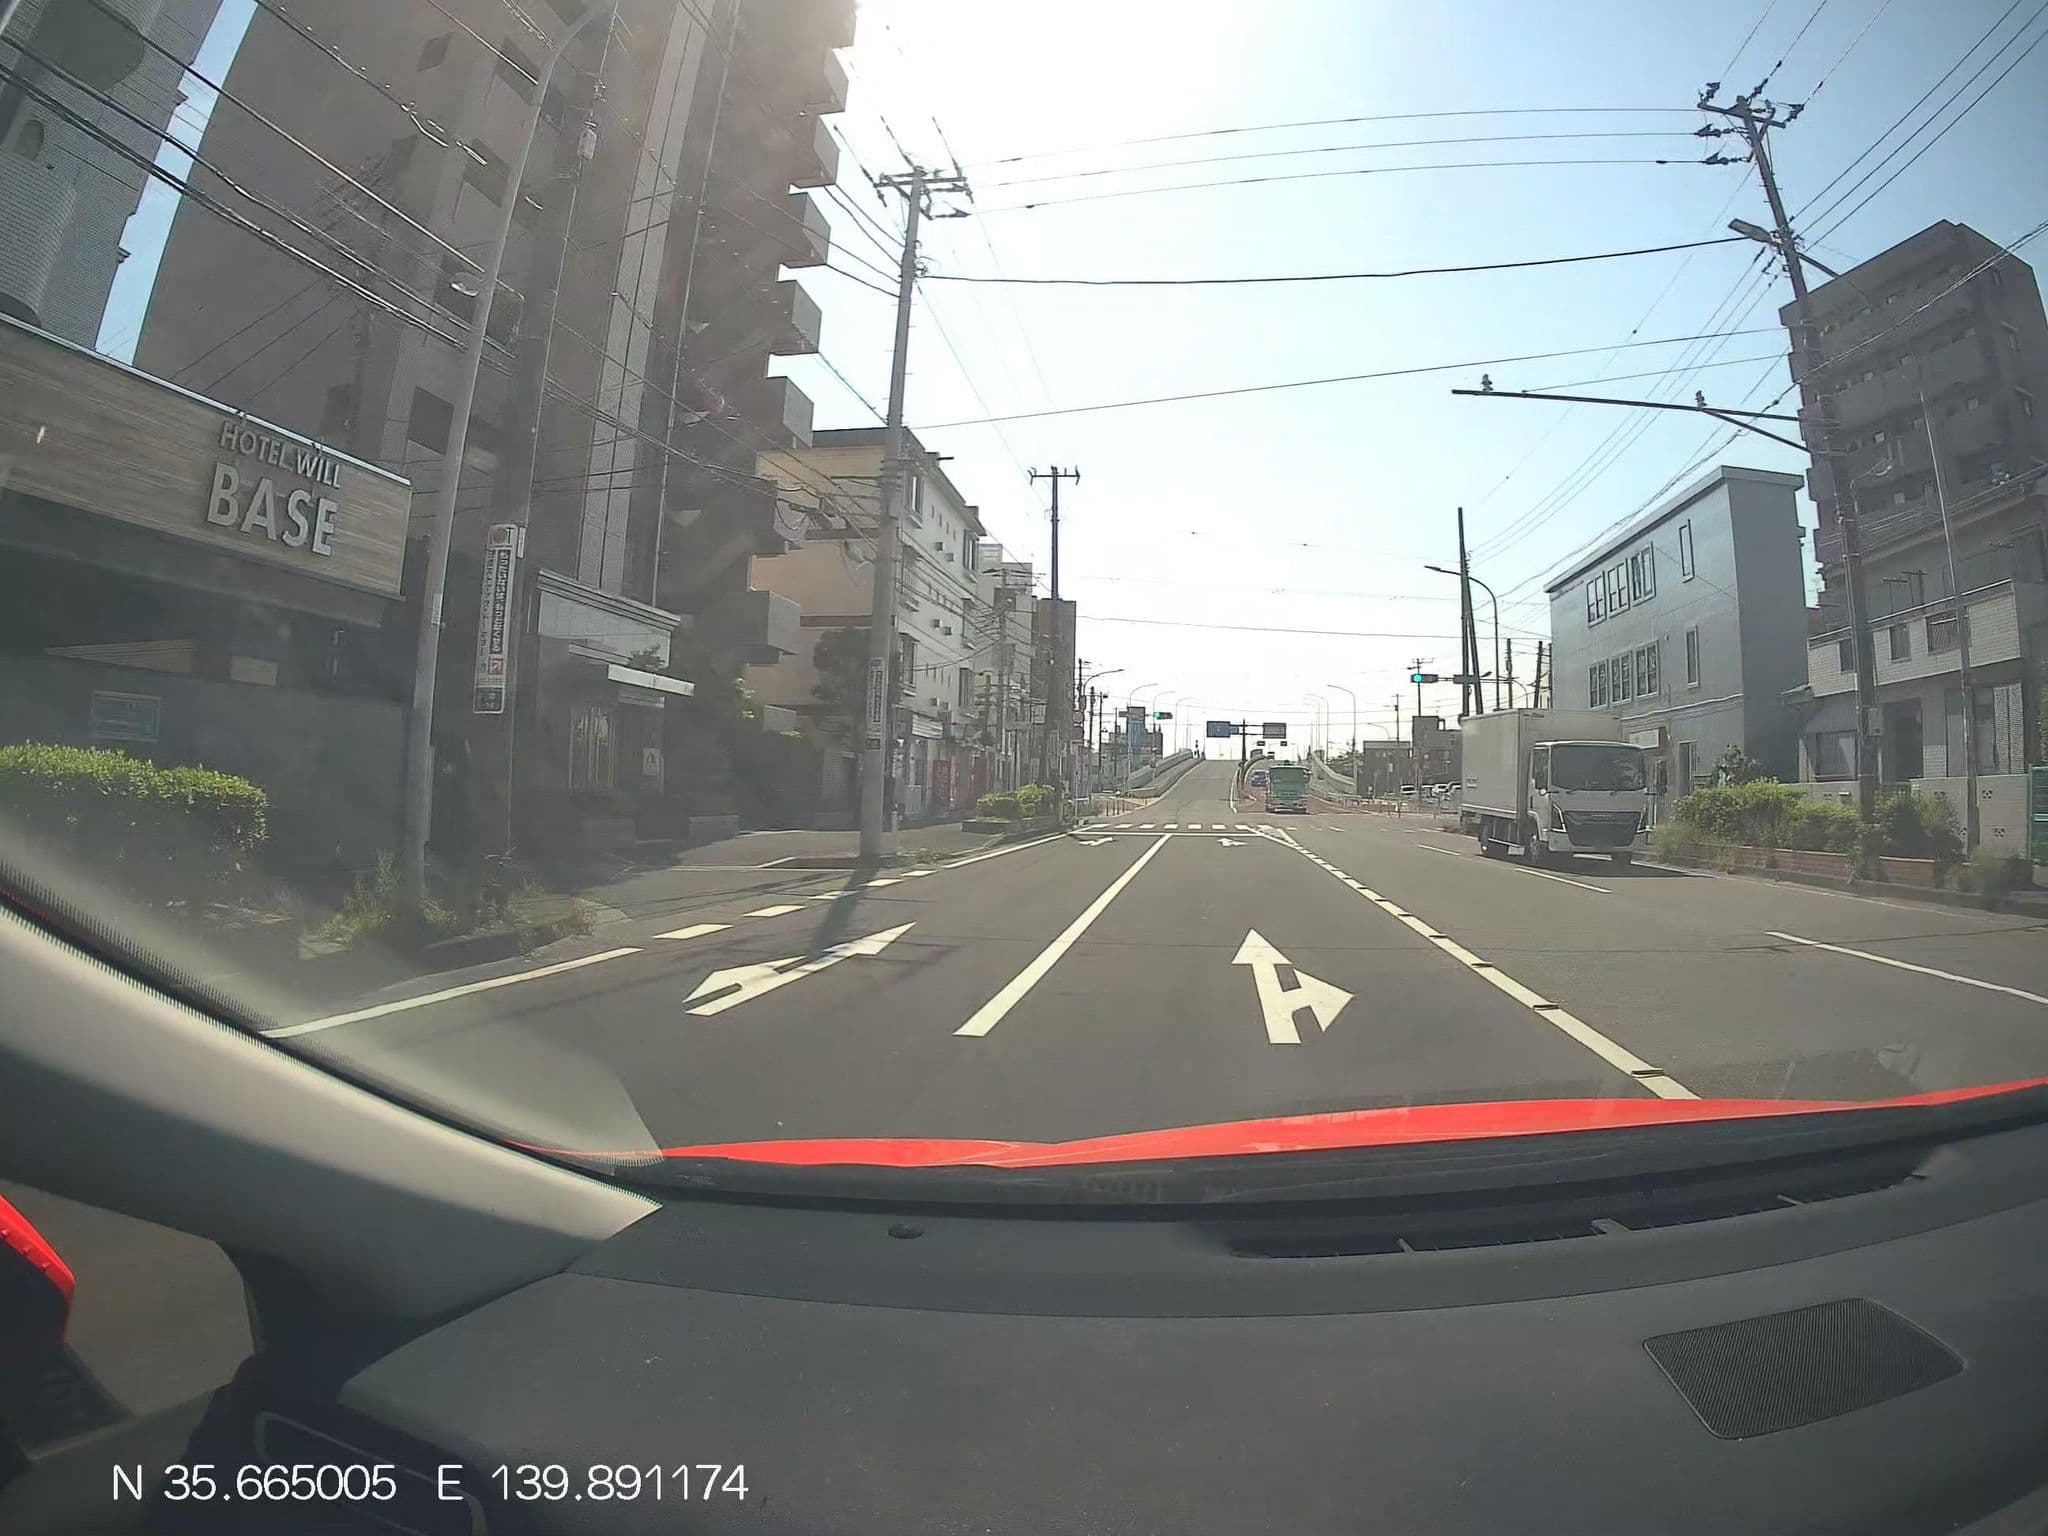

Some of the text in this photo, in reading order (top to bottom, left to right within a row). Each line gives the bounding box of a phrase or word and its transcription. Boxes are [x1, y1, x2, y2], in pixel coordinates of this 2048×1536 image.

[219, 420, 341, 489] HOTEL WILL
[207, 461, 338, 556] BASE
